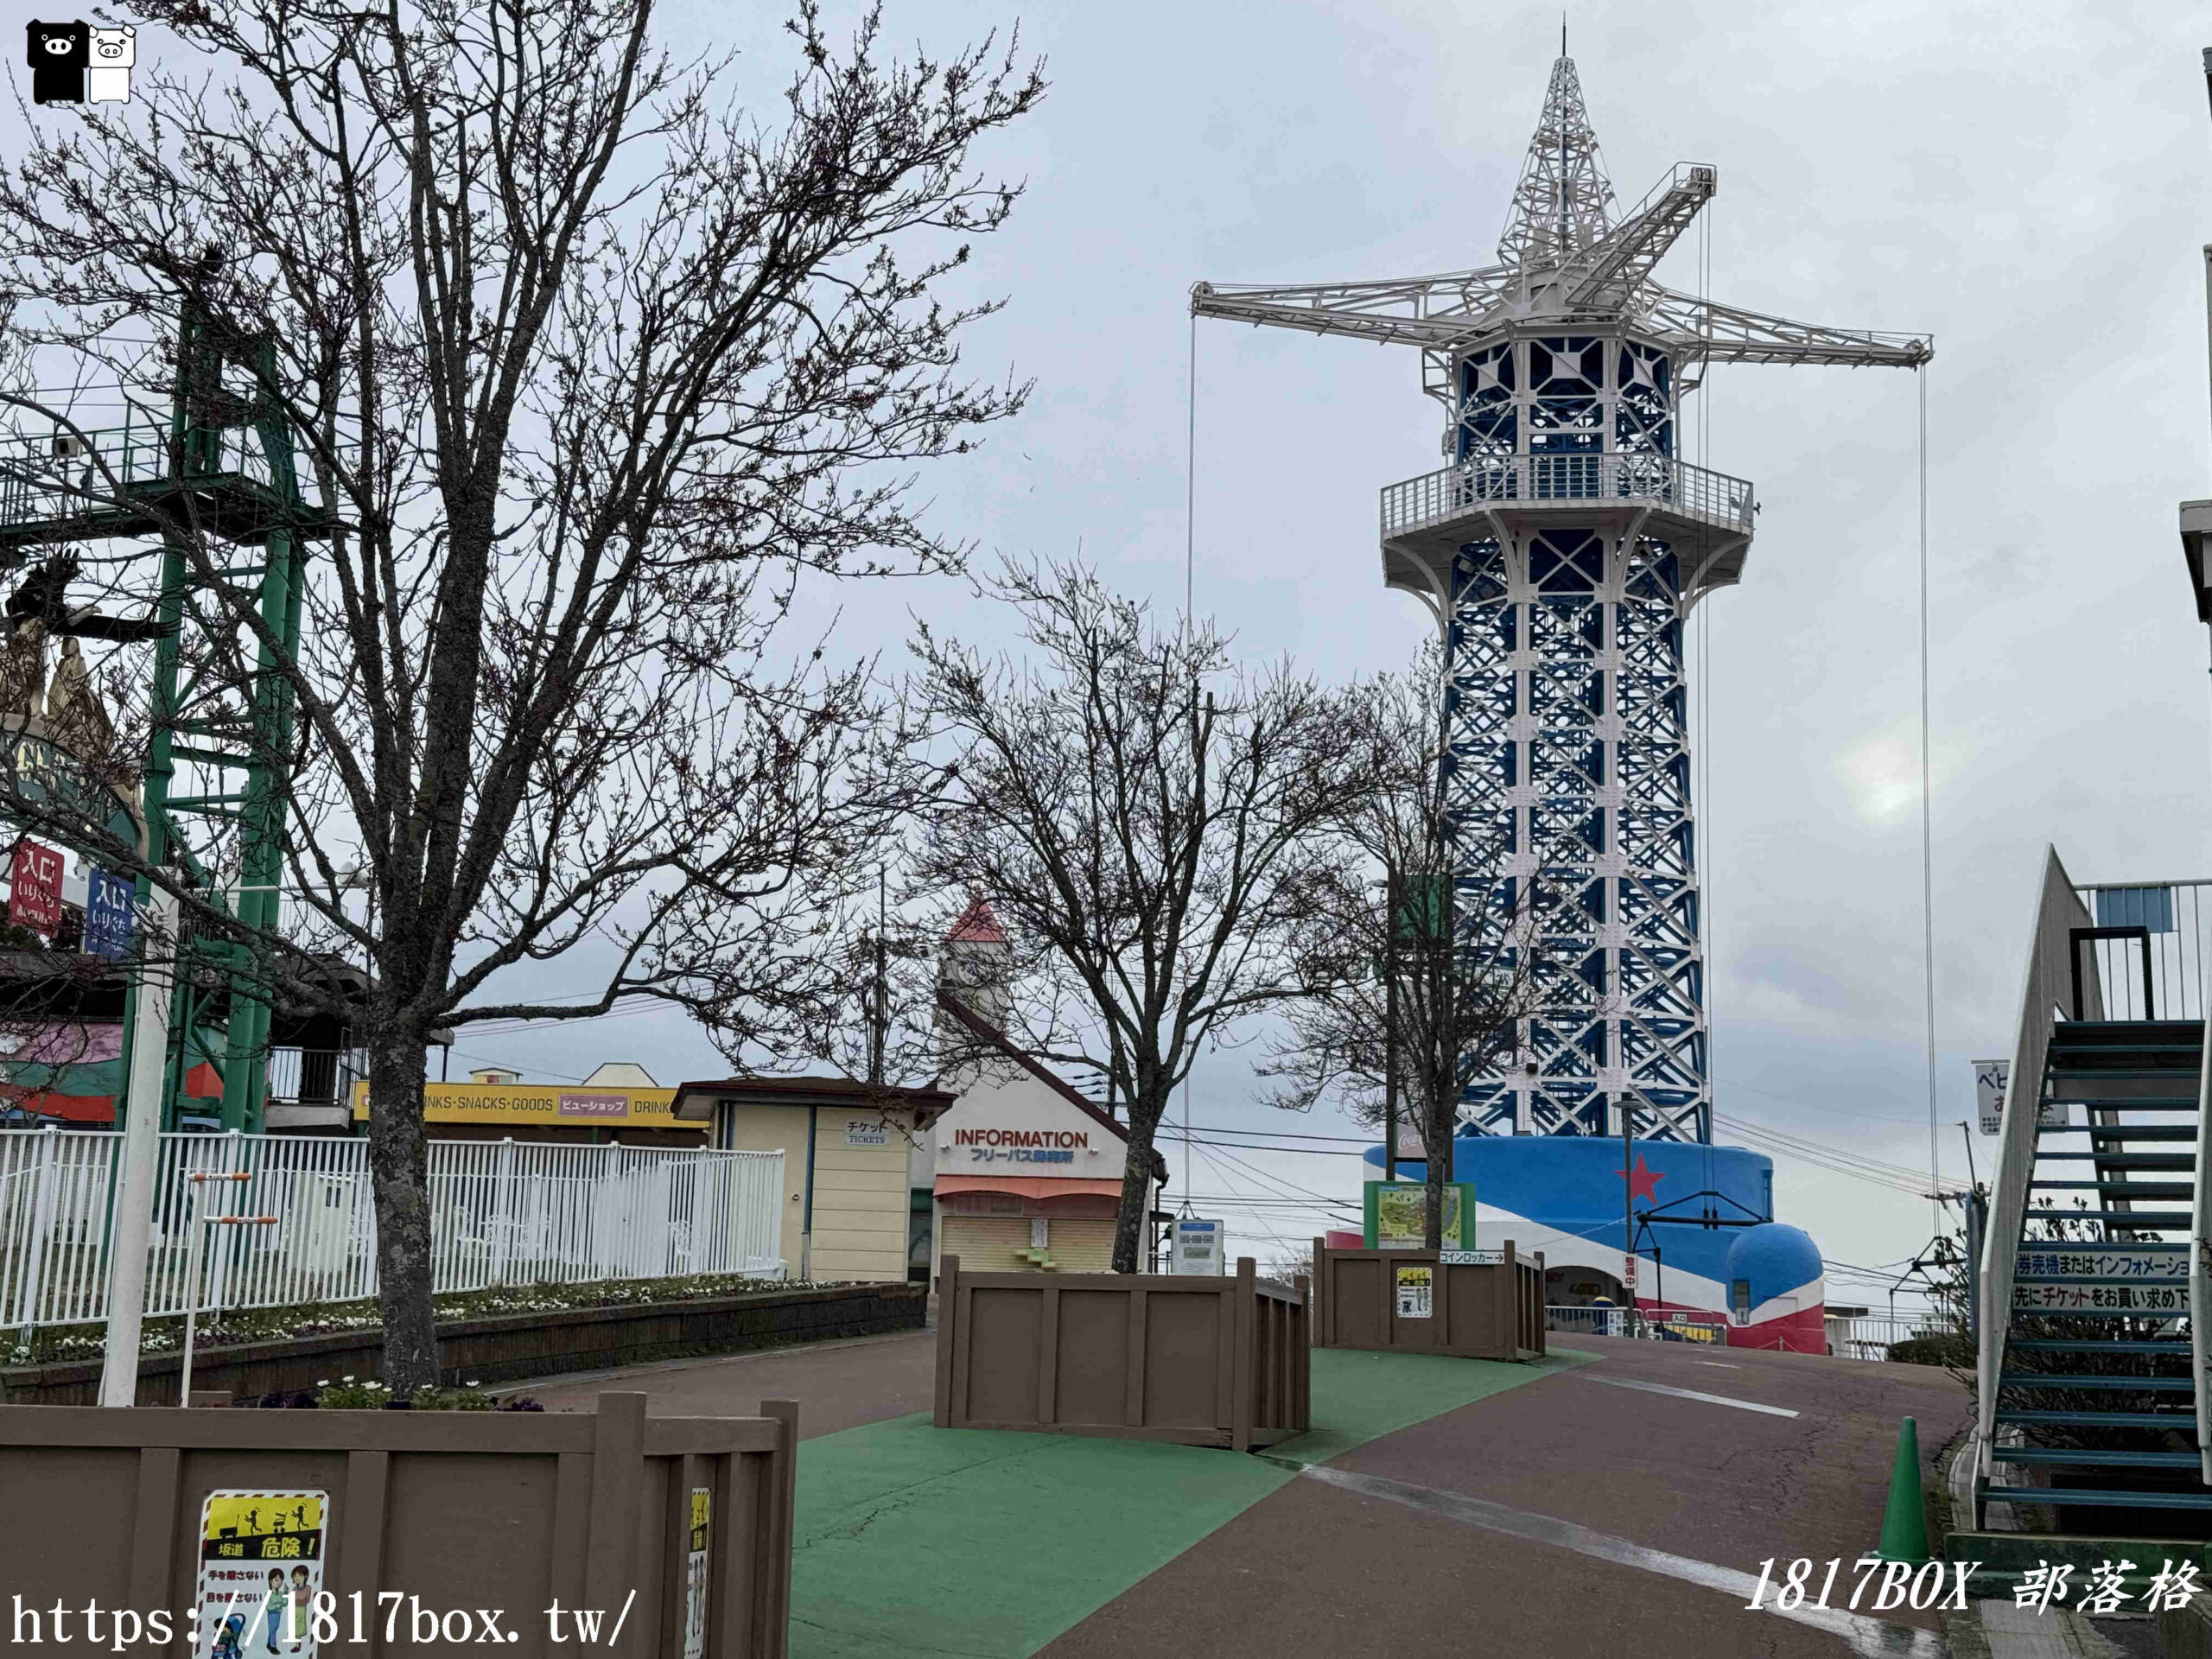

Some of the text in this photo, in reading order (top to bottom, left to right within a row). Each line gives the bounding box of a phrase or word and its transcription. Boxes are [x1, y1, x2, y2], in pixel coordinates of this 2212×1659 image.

[21, 849, 56, 884] 入口
[95, 879, 127, 912] 入口
[563, 1100, 625, 1112] ビューショップ
[634, 1101, 671, 1114] DRINK
[848, 1122, 888, 1134] チケット
[849, 1135, 886, 1144] TICKETS
[955, 1128, 1088, 1148] INFORMATION
[1440, 1252, 1494, 1263] コインロッカー
[2015, 1253, 2190, 1276] 券売機またはインフォメーショ
[218, 1536, 315, 1558] 坂道 危険！
